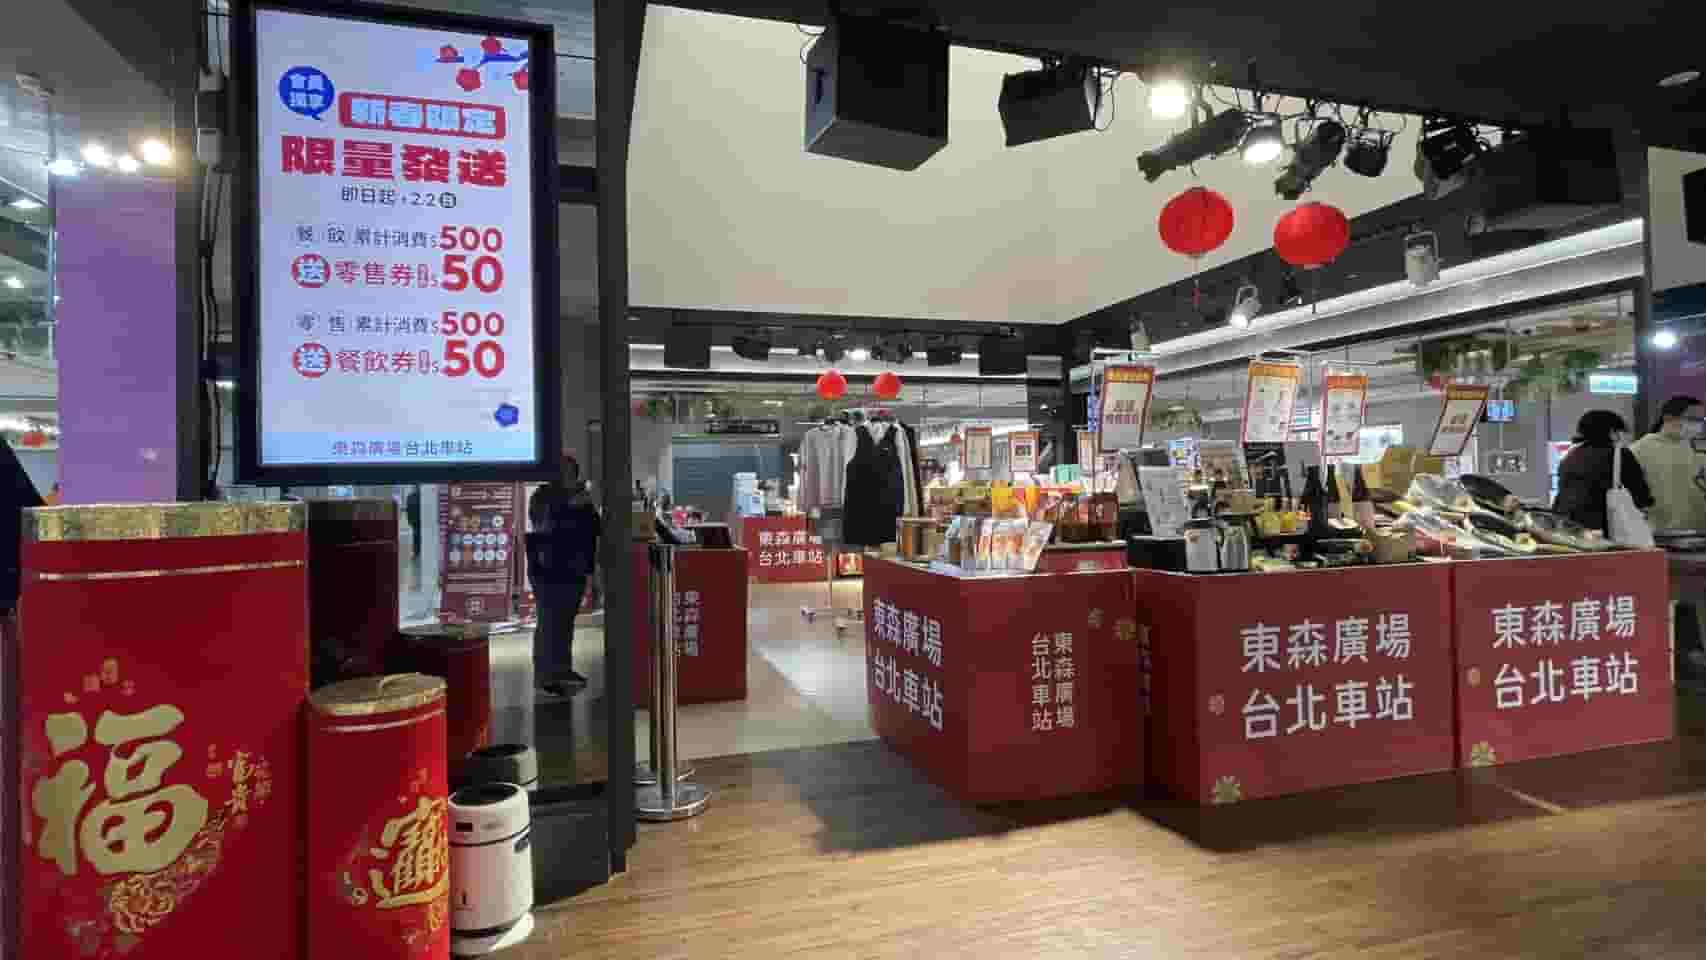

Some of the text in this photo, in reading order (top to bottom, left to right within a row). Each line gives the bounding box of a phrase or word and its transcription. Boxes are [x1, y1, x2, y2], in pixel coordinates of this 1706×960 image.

[280, 134, 507, 188] 限量發送
[873, 596, 945, 668] 東森廣場
[1240, 613, 1412, 673] 東森廣場
[1491, 596, 1638, 649] 東森廣場
[873, 647, 945, 733] 台北車站
[1031, 631, 1053, 733] 台北車站
[1054, 631, 1076, 729] 東森廣場
[1241, 674, 1415, 740] 台北車站
[1493, 650, 1640, 709] 台北車站
[32, 703, 209, 878] 福
